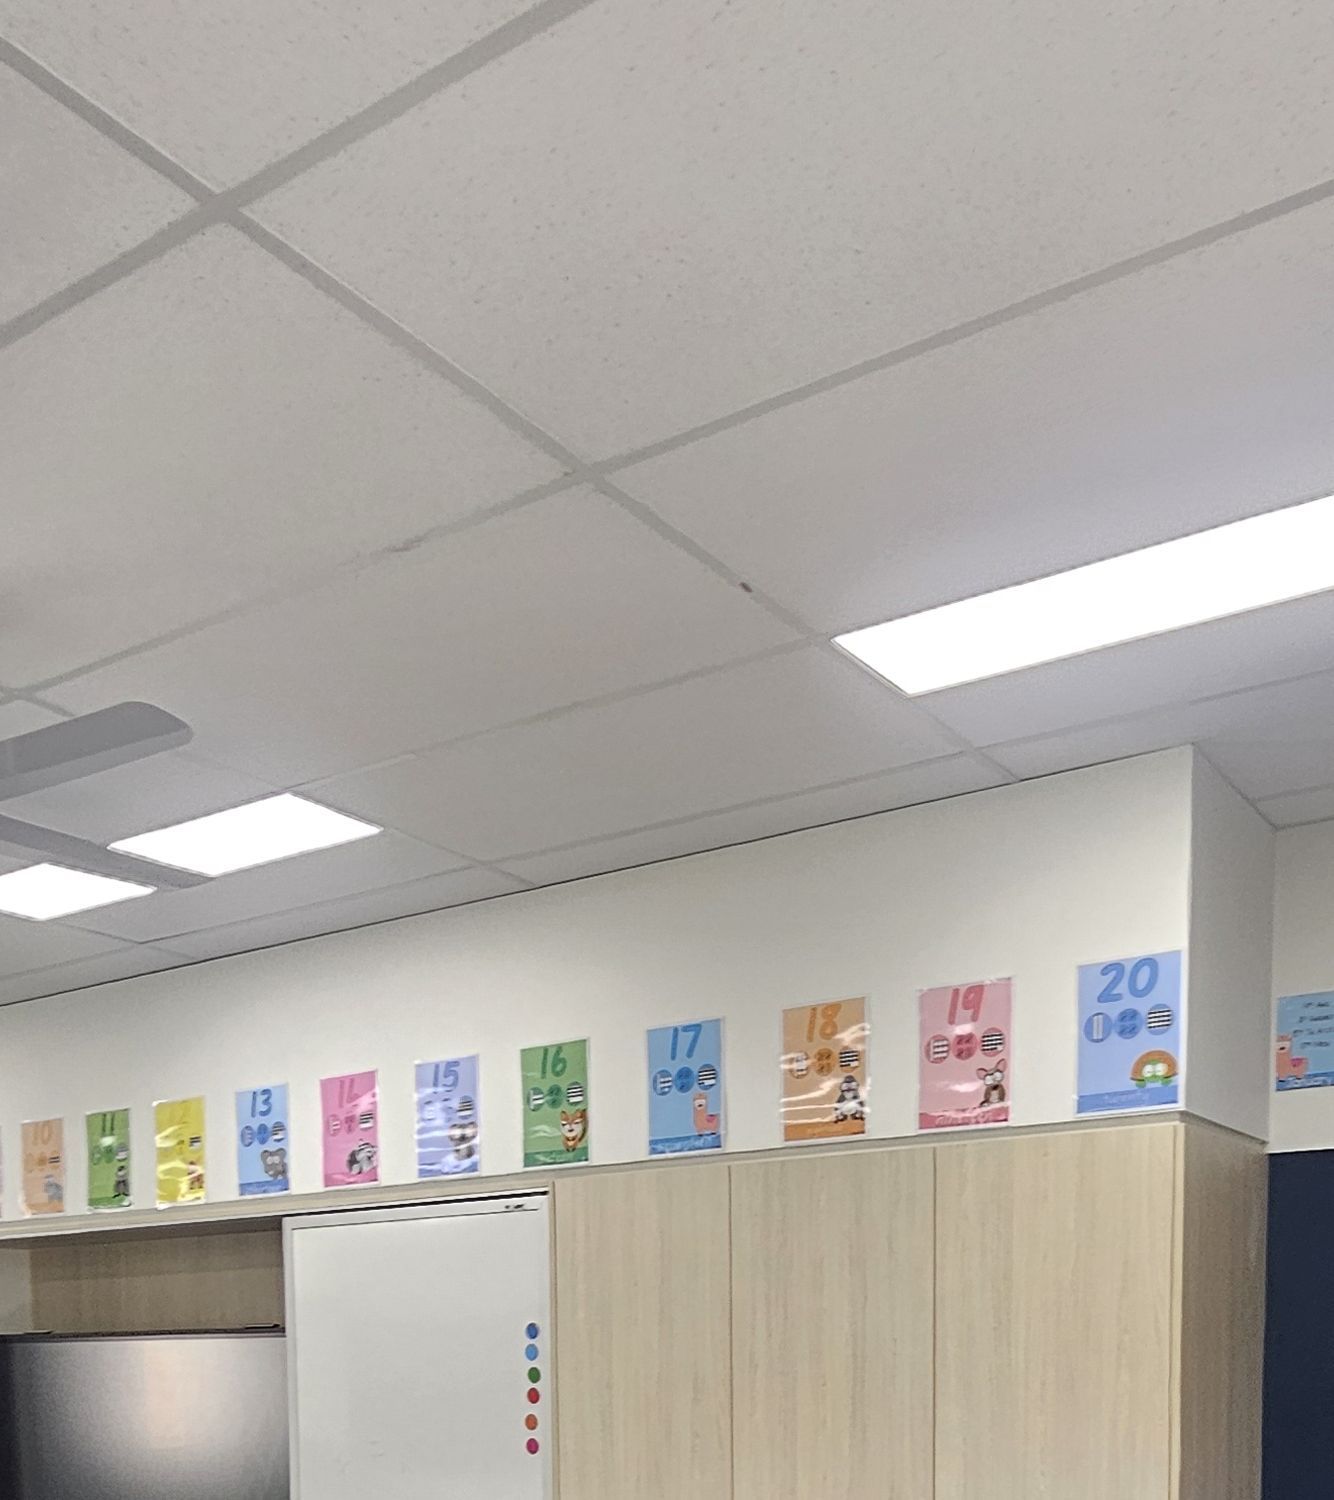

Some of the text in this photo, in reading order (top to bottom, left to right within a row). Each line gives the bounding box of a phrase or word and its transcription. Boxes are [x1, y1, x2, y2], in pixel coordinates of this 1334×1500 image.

[1097, 957, 1159, 1003] 20
[948, 985, 985, 1025] 19
[807, 1002, 842, 1042] 18
[671, 1023, 702, 1061] 17
[433, 1060, 461, 1090] 15
[541, 1046, 567, 1079] 16
[251, 1088, 272, 1117] 13
[32, 1121, 53, 1146] 10
[102, 1113, 115, 1134] 11
